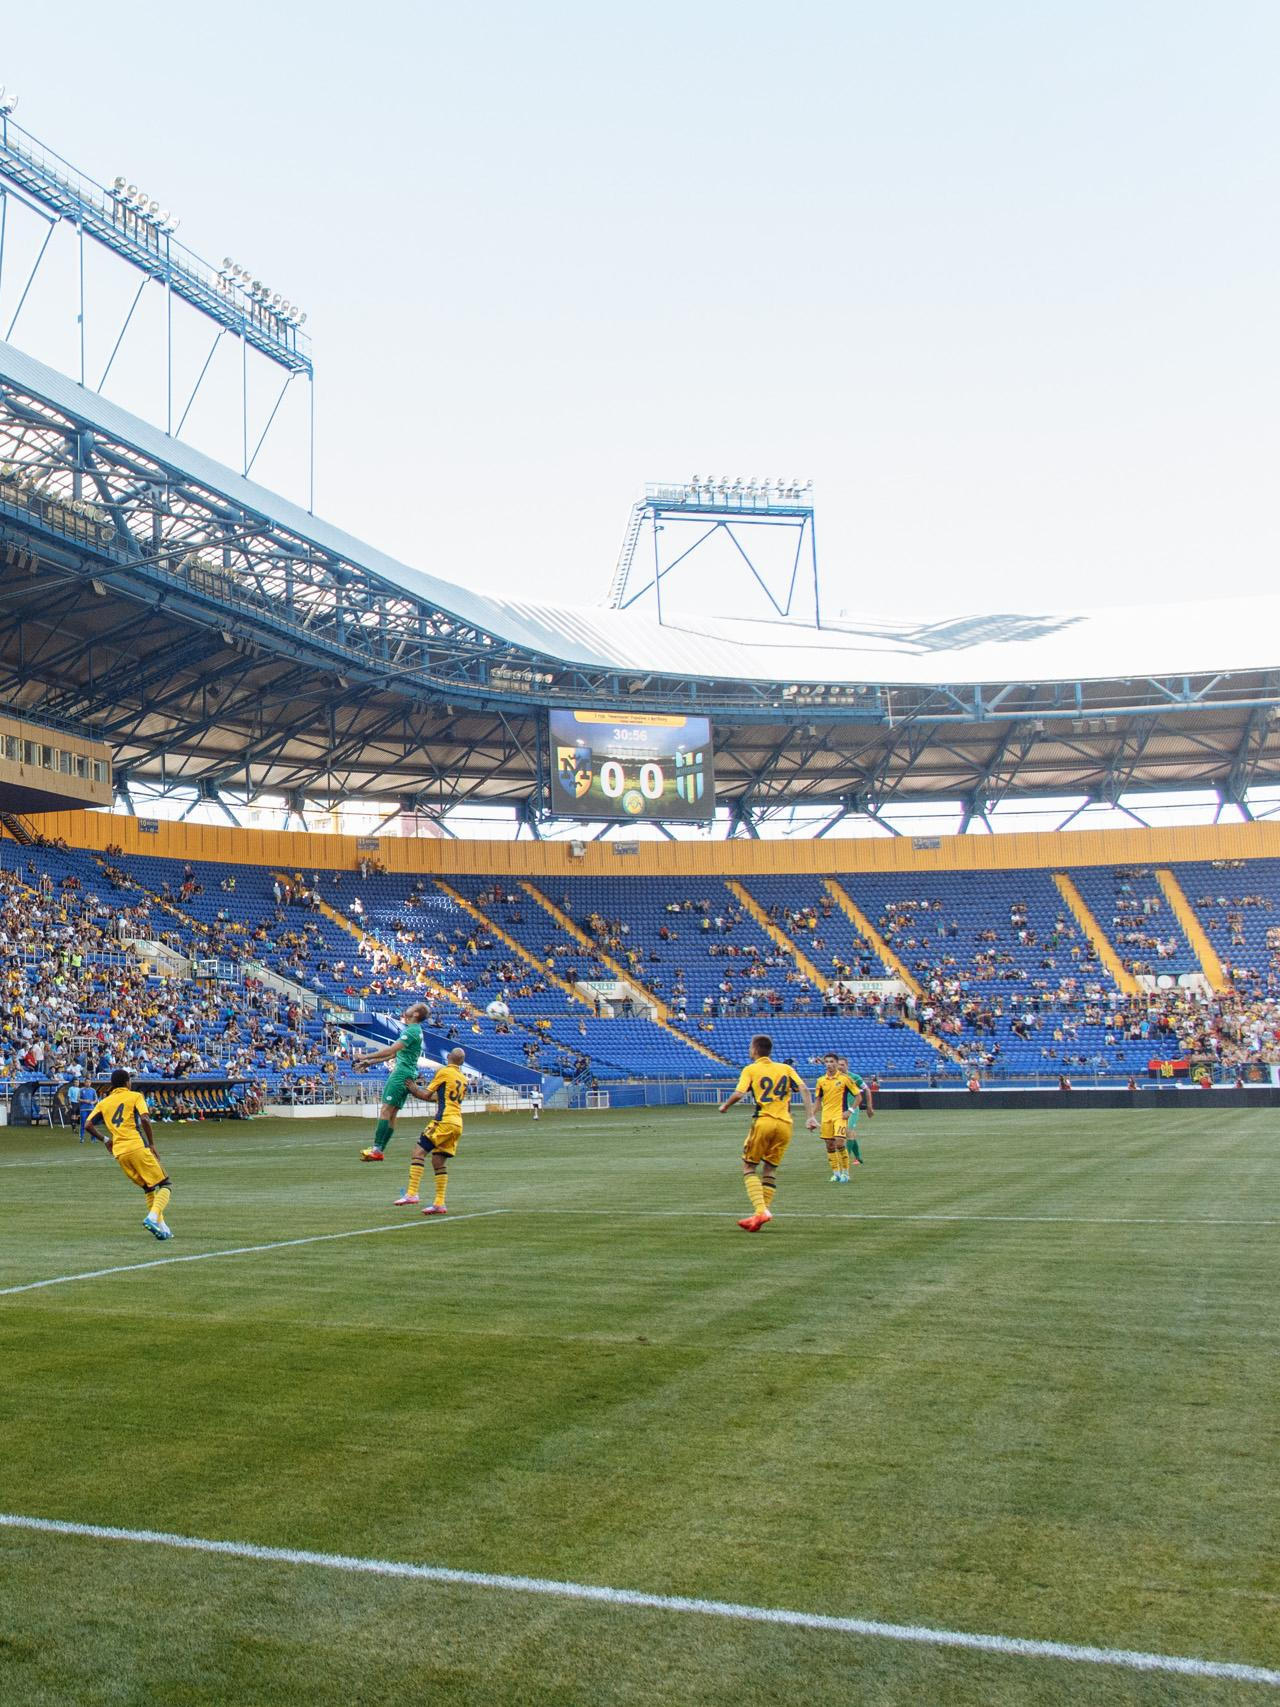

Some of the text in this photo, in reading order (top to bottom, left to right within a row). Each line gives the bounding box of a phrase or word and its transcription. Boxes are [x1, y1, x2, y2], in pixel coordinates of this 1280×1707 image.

[613, 728, 648, 742] 30:56
[600, 761, 664, 799] 0 0
[760, 1074, 788, 1103] 24
[111, 1102, 125, 1128] 4
[836, 1125, 847, 1136] 10
